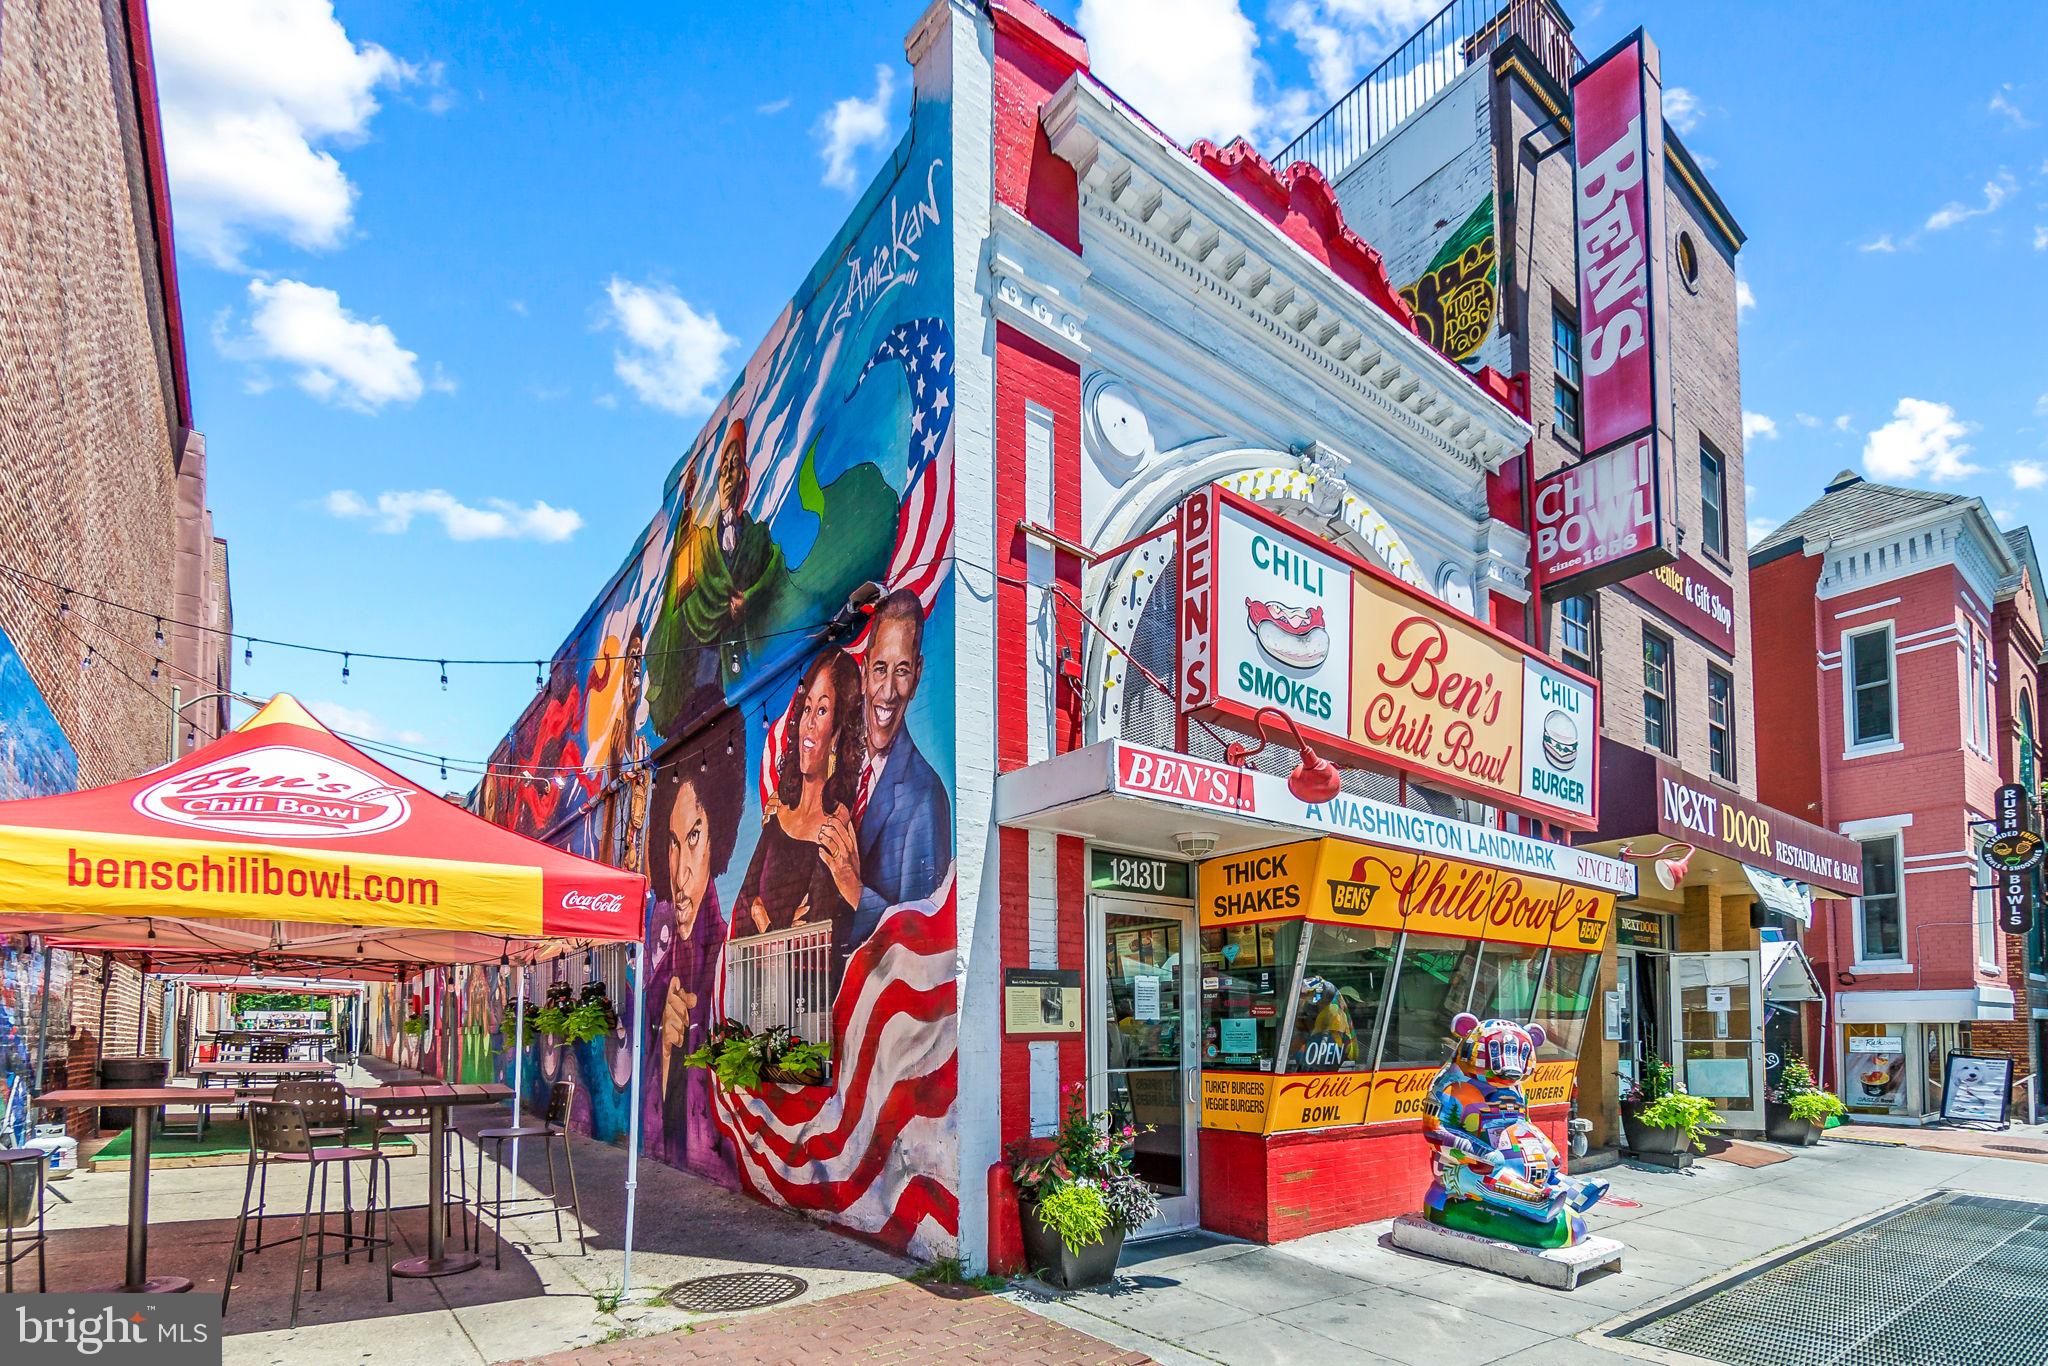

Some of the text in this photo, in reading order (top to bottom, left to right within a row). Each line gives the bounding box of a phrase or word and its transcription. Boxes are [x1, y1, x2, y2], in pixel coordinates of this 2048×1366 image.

[1537, 489, 1654, 563] BOWL
[1251, 535, 1323, 597] CHILI
[1549, 556, 1582, 574] since
[1184, 492, 1209, 705] BEN'S
[1685, 577, 1694, 603] &
[1694, 583, 1711, 614] Gift
[1711, 595, 1732, 634] Shop
[1377, 616, 1503, 726] Ben's
[1238, 661, 1332, 720] SMOKES
[1540, 675, 1580, 714] CHILI
[1364, 692, 1513, 784] Chili Bowl
[171, 766, 351, 794] Ben's
[1532, 767, 1585, 805] BURGER
[182, 796, 361, 821] Chili Bowl
[2003, 789, 2017, 829] RUSH
[1305, 800, 1323, 823] A
[1329, 797, 1463, 852] WASHINGTON
[1467, 829, 1557, 871] LANDMARK
[1577, 855, 1612, 885] SINCE
[1721, 803, 1773, 858] DOOR
[1775, 840, 1833, 878] RESTAURANT
[1833, 860, 1842, 880] &
[1841, 863, 1859, 885] BAR
[1985, 830, 2041, 849] BLENDED FRUIT
[68, 848, 439, 906] benschilibowl.com
[1222, 853, 1289, 886] THICK
[561, 890, 625, 913] Coca-Cola
[1213, 884, 1300, 918] SHAKES
[1334, 885, 1370, 911] BEN'S
[1392, 859, 1578, 932] Chili Bowl
[2006, 874, 2025, 926] BOWLS
[1580, 922, 1601, 940] BEN'S
[1305, 1041, 1345, 1066] OPEN
[1205, 1080, 1265, 1096] TURKEY BURGERS
[1300, 1077, 1357, 1100] Chili
[1533, 1065, 1567, 1083] Chili
[1205, 1097, 1265, 1114] VEGGIE BURGERS
[1394, 1098, 1426, 1115] DOGS
[1525, 1086, 1565, 1101] BURGERS
[1301, 1106, 1341, 1123] BOWL
